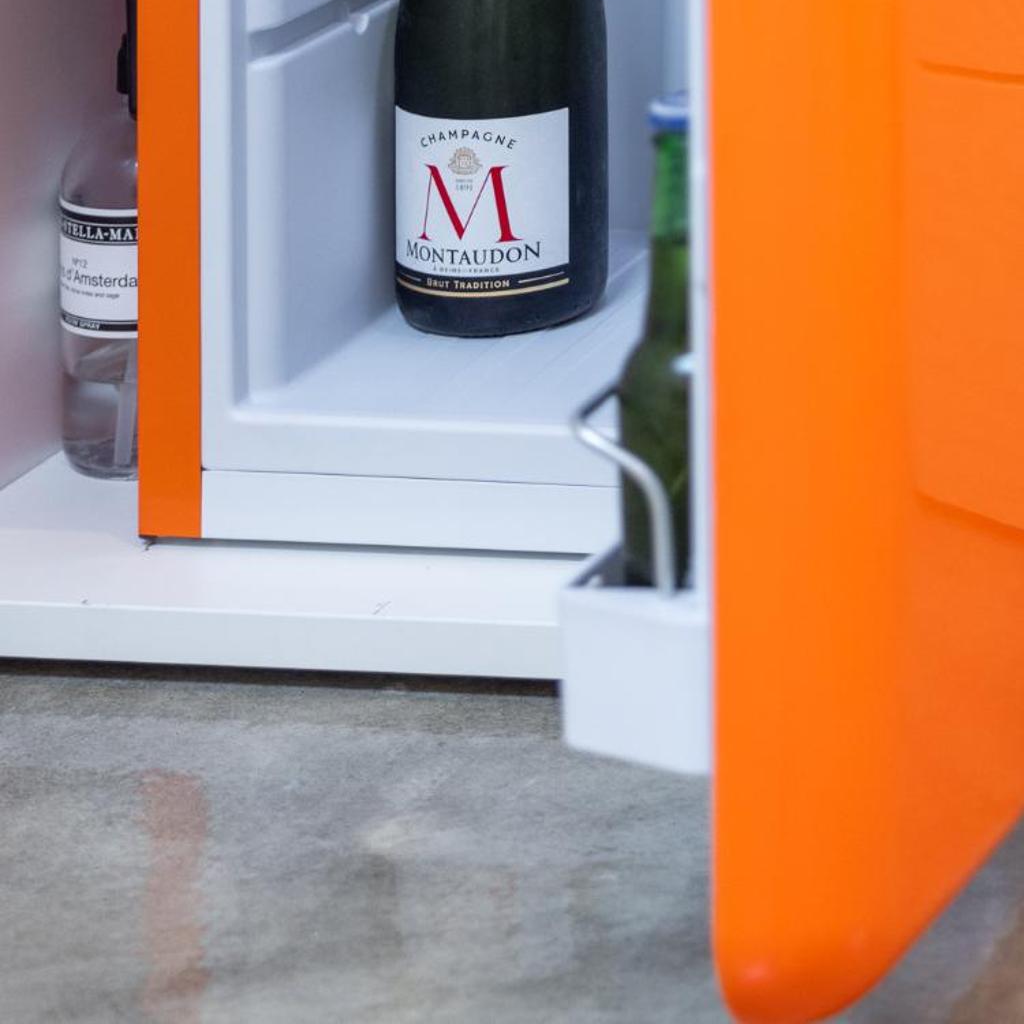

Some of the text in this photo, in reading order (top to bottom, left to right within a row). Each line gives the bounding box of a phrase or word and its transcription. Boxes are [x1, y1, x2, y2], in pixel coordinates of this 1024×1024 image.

[420, 128, 518, 150] CHAMPAGNE
[418, 164, 524, 243] M
[406, 239, 541, 265] MONTAUDON
